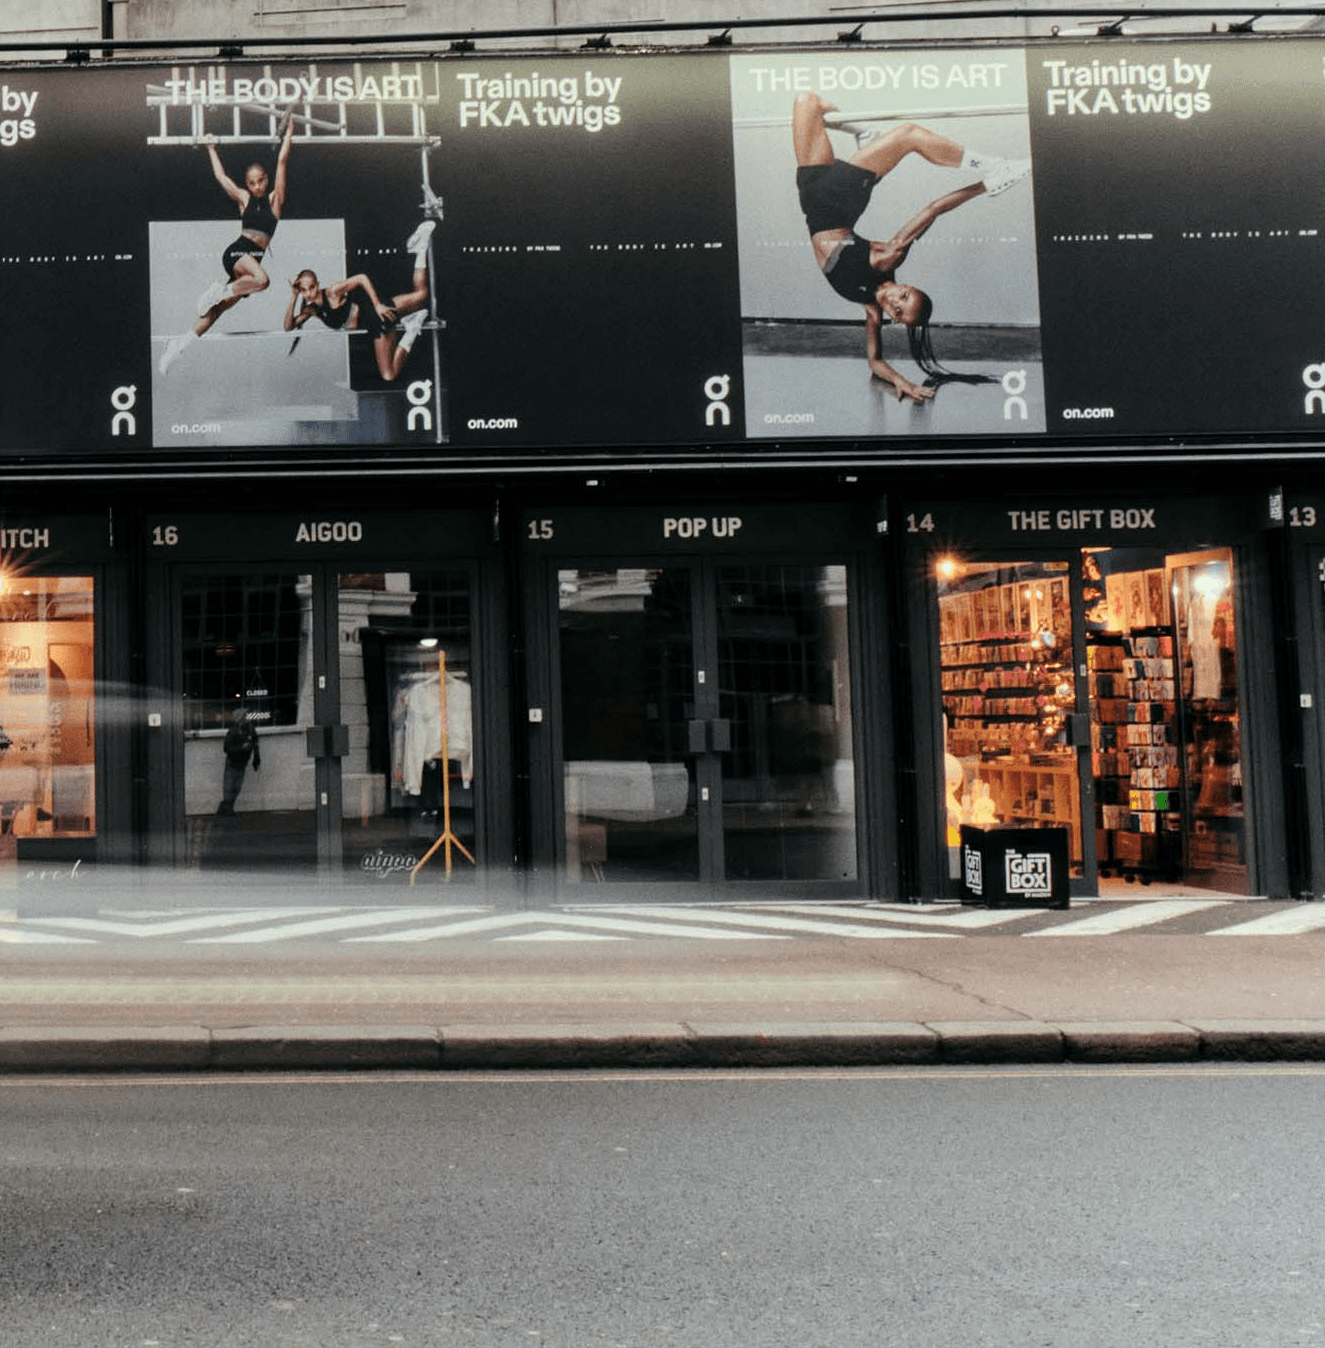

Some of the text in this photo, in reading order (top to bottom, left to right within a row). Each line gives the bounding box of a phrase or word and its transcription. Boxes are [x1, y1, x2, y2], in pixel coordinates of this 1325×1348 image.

[749, 63, 1009, 92] THE BODY IS ART
[1043, 57, 1212, 91] Training by
[164, 74, 421, 104] THE BODY IS ART
[456, 70, 622, 104] Training by
[2, 85, 39, 118] by
[1047, 86, 1211, 119] FKA twigs
[459, 99, 621, 132] FKA twigs
[763, 411, 815, 423] on.com
[1062, 407, 1114, 420] on.com
[171, 423, 221, 434] on.com
[467, 418, 517, 430] on.com
[907, 513, 935, 533] 14
[1008, 509, 1156, 530] THE GIFT BOX
[1289, 506, 1316, 527] 13
[153, 526, 179, 545] 16
[295, 522, 362, 542] AIGOO
[528, 520, 554, 539] 15
[663, 517, 742, 538] POP UP
[1010, 858, 1047, 873] GIFT
[1011, 873, 1047, 888] BOX
